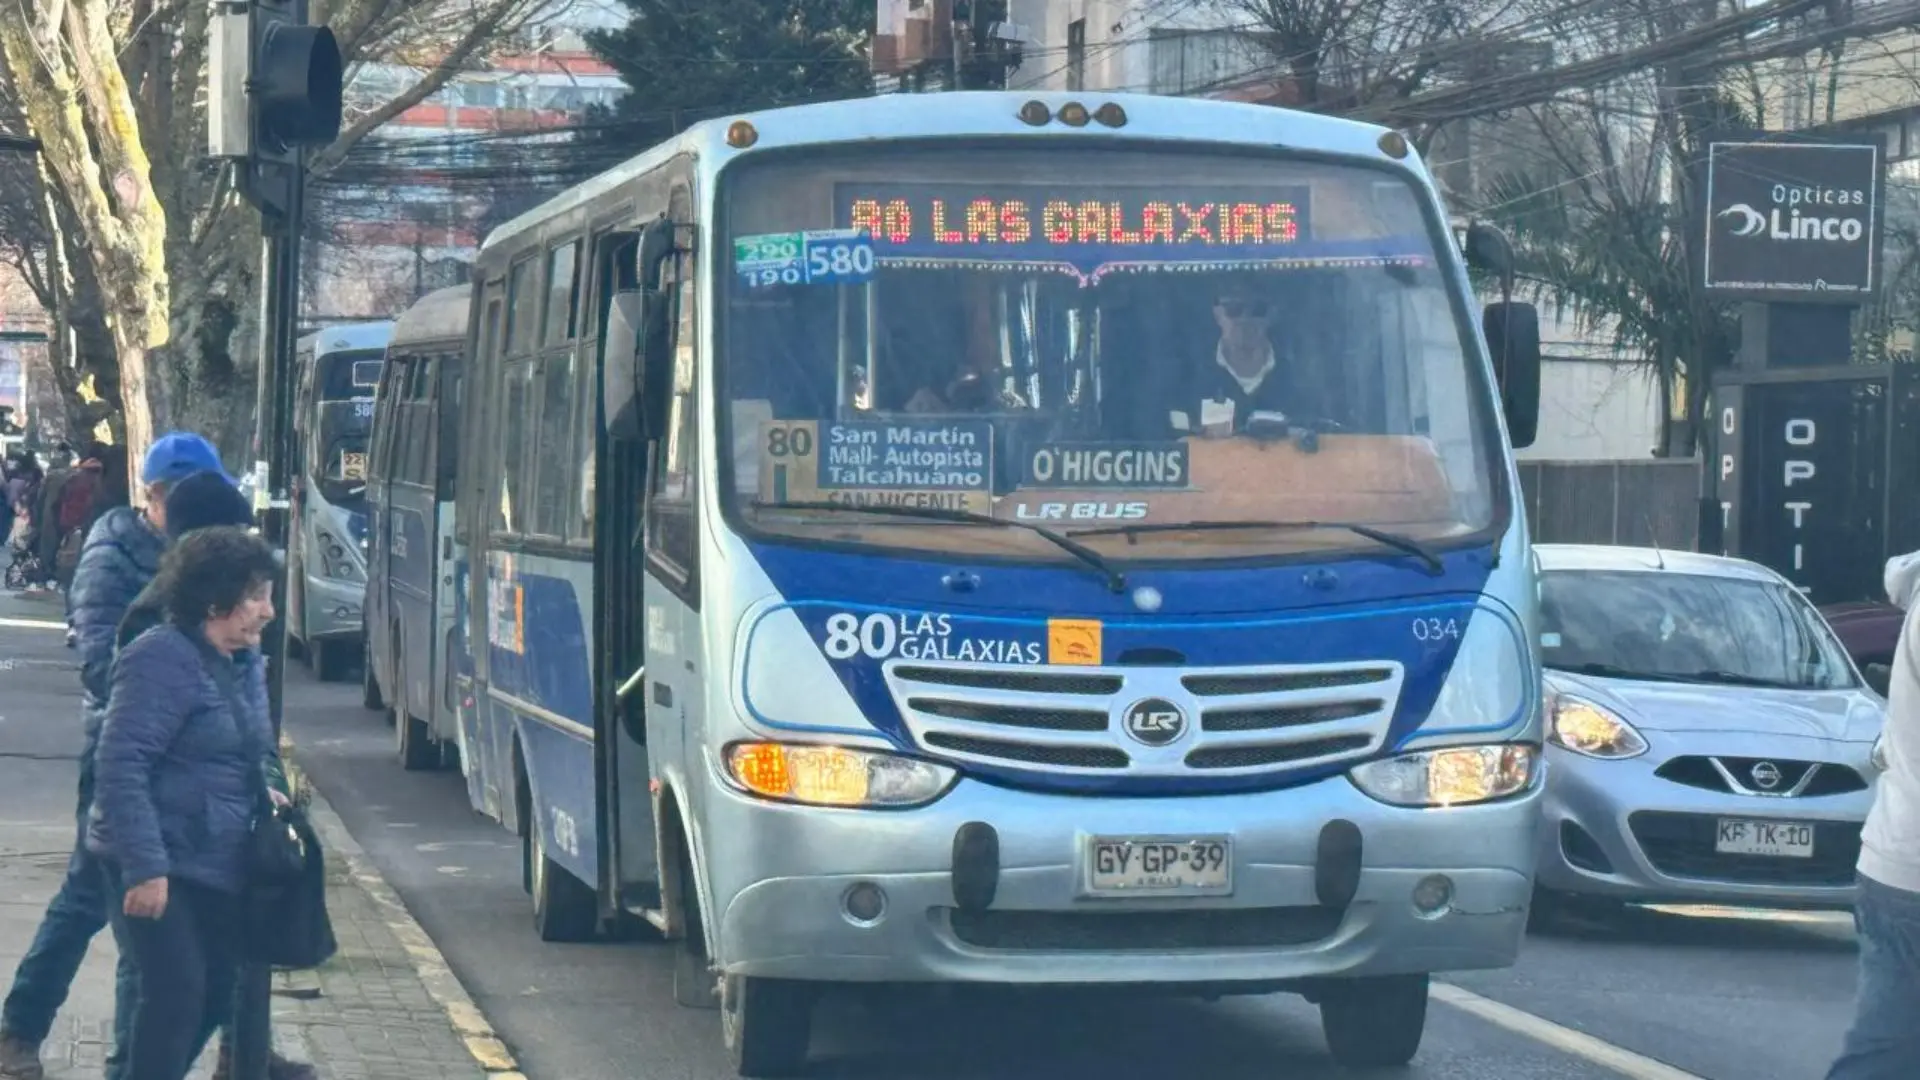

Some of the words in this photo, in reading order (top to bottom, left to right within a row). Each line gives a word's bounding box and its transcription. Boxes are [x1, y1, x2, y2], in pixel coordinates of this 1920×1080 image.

[932, 199, 1032, 243] LAS
[1043, 200, 1297, 245] GALAXIAS
[1770, 208, 1862, 241] Linco
[810, 244, 874, 276] 580
[745, 268, 800, 287] 190
[767, 427, 812, 457] 80
[830, 426, 877, 444] San
[884, 447, 984, 470] Autopista
[828, 466, 982, 486] Talcahuano
[1070, 502, 1148, 519] BUS
[824, 613, 896, 659] 80
[900, 614, 952, 636] LAS
[1412, 617, 1459, 641] 034
[900, 637, 1041, 665] GALAXIAS
[1132, 711, 1180, 731] LR
